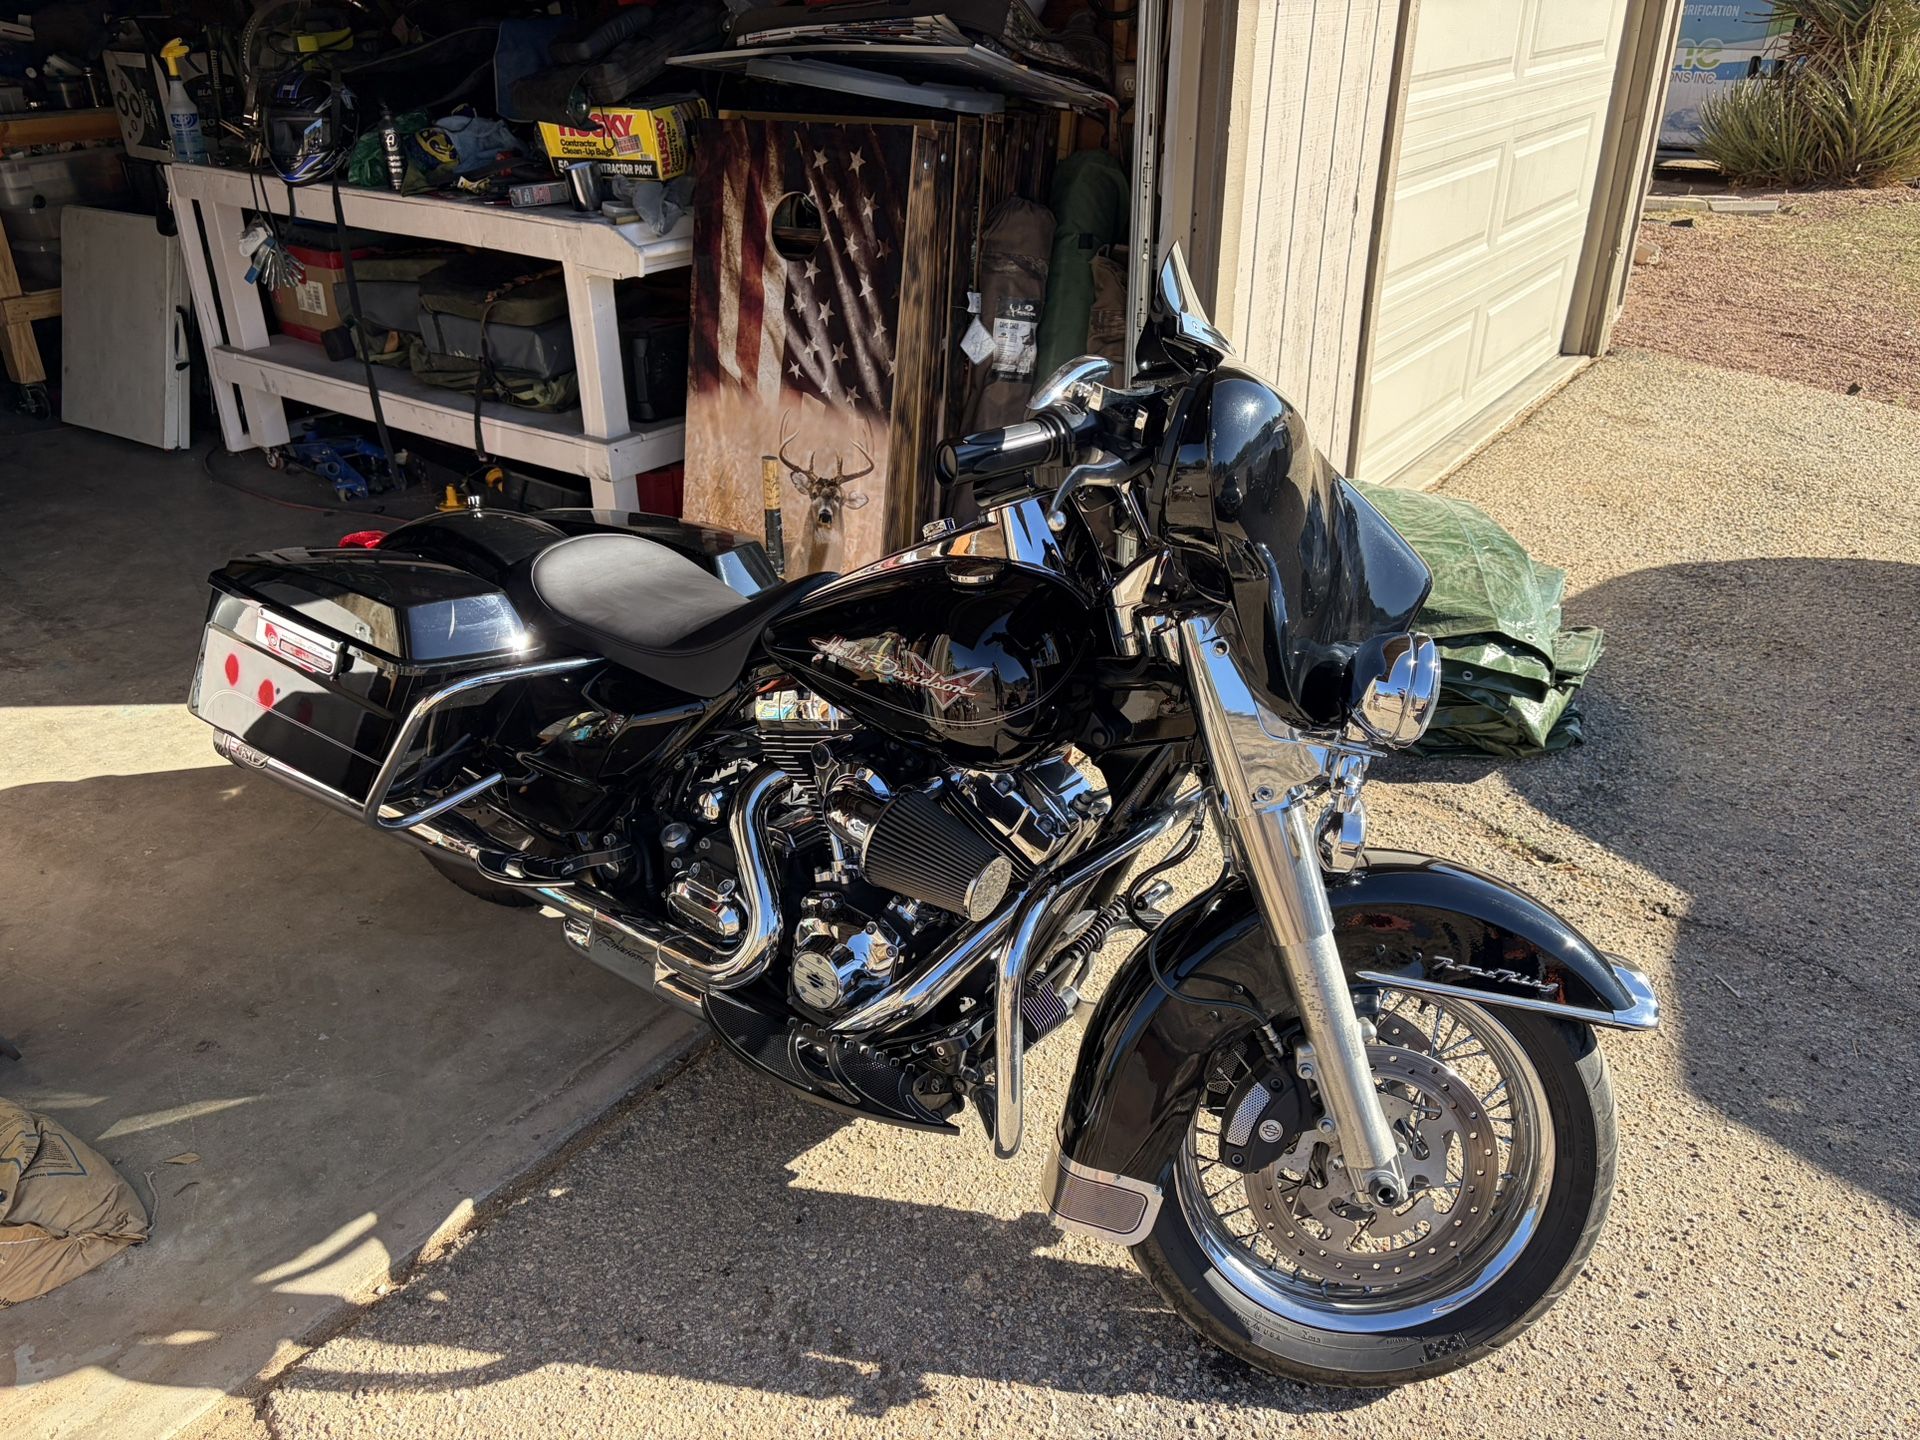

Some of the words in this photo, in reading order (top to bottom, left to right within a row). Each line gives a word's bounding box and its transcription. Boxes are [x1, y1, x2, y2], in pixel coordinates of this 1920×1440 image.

[560, 139, 597, 147] Contractor
[656, 116, 671, 176] HUSKY
[634, 164, 653, 176] PACK
[811, 635, 977, 696] Harley-Davidson
